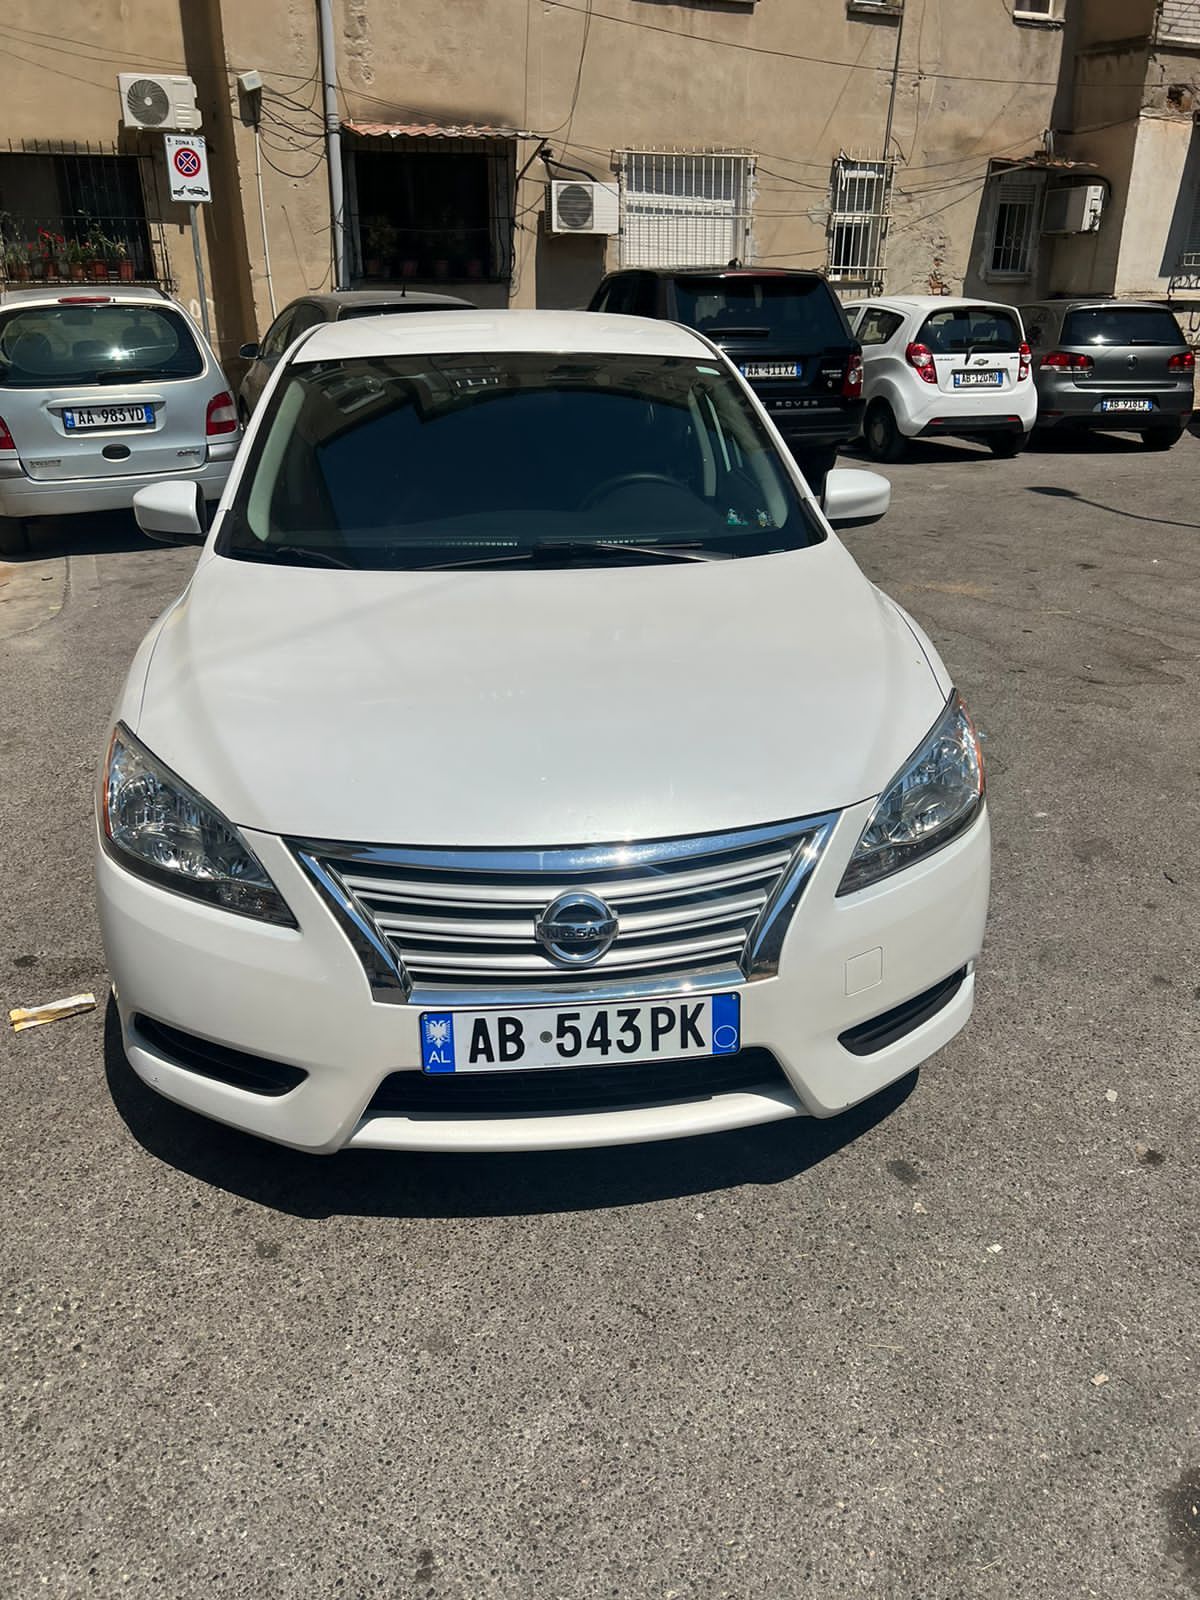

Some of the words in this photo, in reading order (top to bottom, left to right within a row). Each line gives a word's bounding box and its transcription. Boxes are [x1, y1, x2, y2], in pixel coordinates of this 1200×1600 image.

[776, 400, 819, 408] ROVER
[78, 410, 96, 425] AA
[101, 407, 144, 424] 983VD
[544, 925, 614, 940] NISSAN
[468, 1016, 526, 1064] AB
[555, 1002, 706, 1058] 543PK
[428, 1050, 451, 1065] AL
